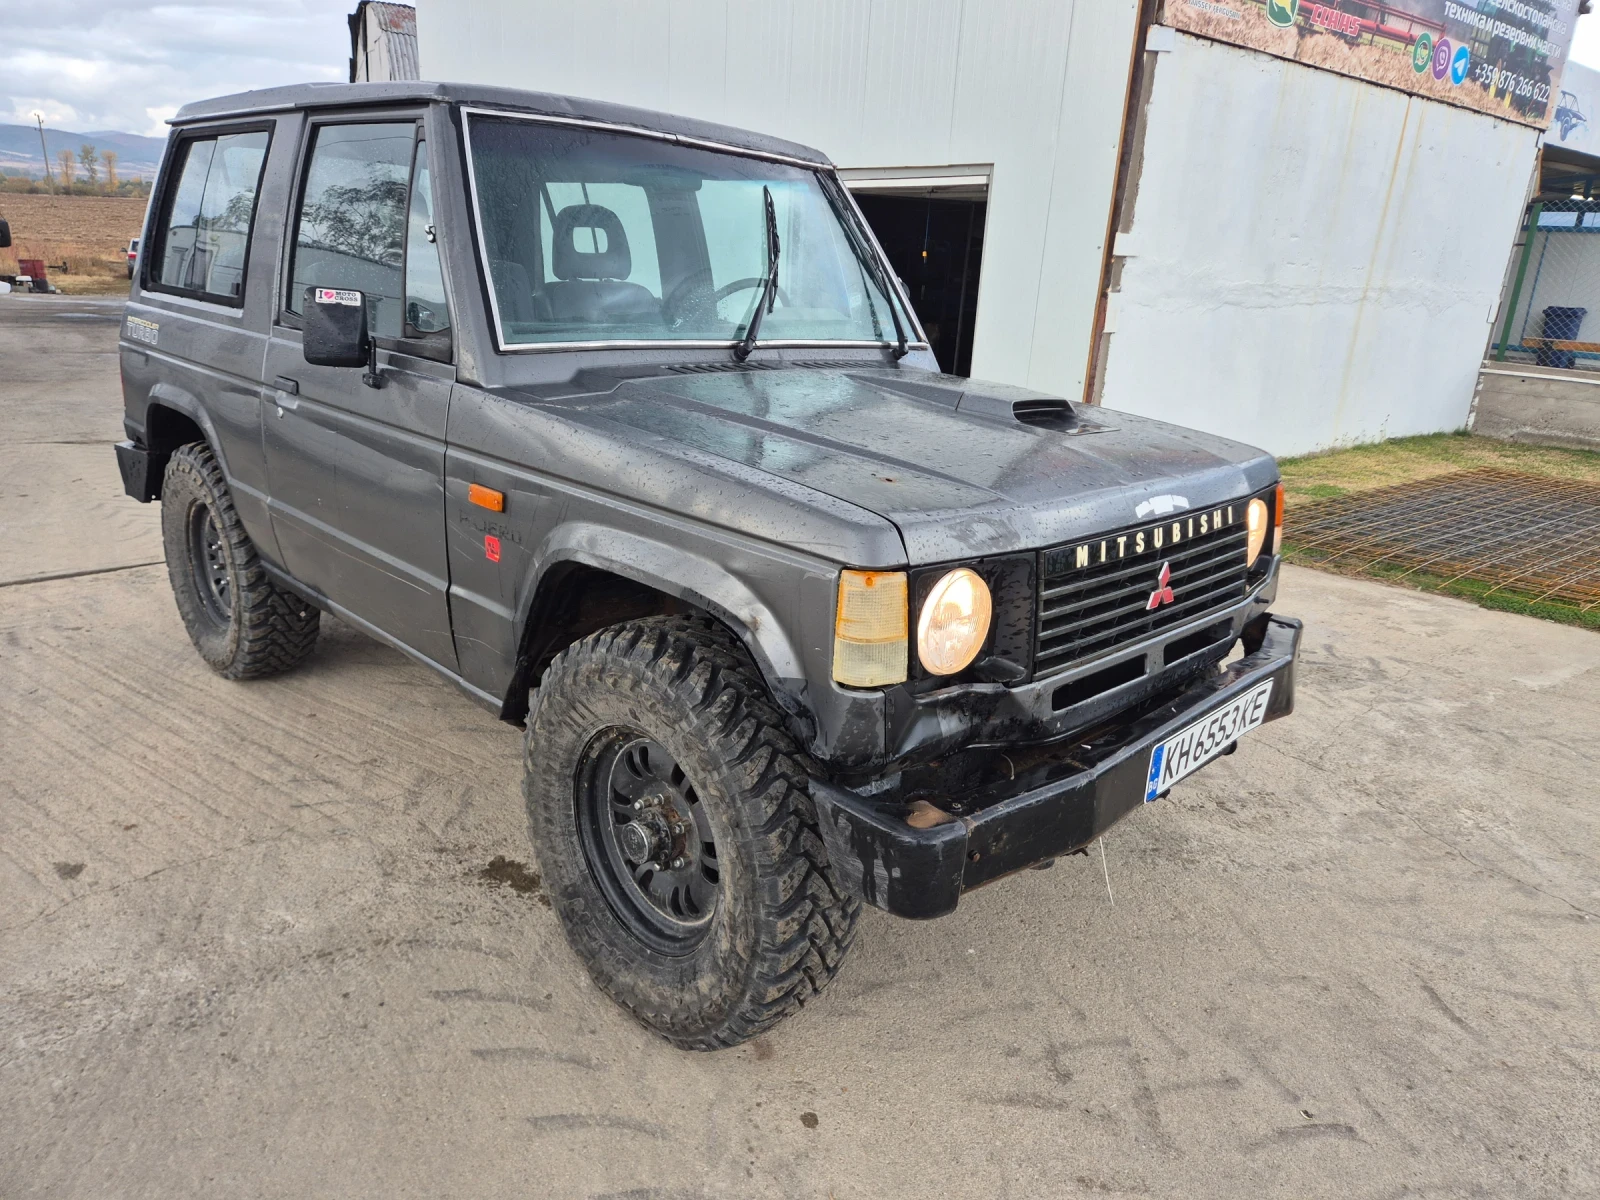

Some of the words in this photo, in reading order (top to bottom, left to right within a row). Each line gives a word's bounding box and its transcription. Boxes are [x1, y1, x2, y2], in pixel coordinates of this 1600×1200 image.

[1310, 4, 1361, 36] CLAAS
[1444, 1, 1486, 31] техника
[1485, 17, 1493, 32] и
[1492, 20, 1537, 50] резервни
[1537, 38, 1562, 59] части
[1475, 63, 1499, 85] +359
[1498, 69, 1516, 92] 876
[1515, 76, 1534, 98] 266
[1533, 82, 1551, 103] 622
[126, 321, 159, 345] TURBO
[1076, 506, 1233, 568] MITSUBISHI
[1148, 778, 1158, 793] BG
